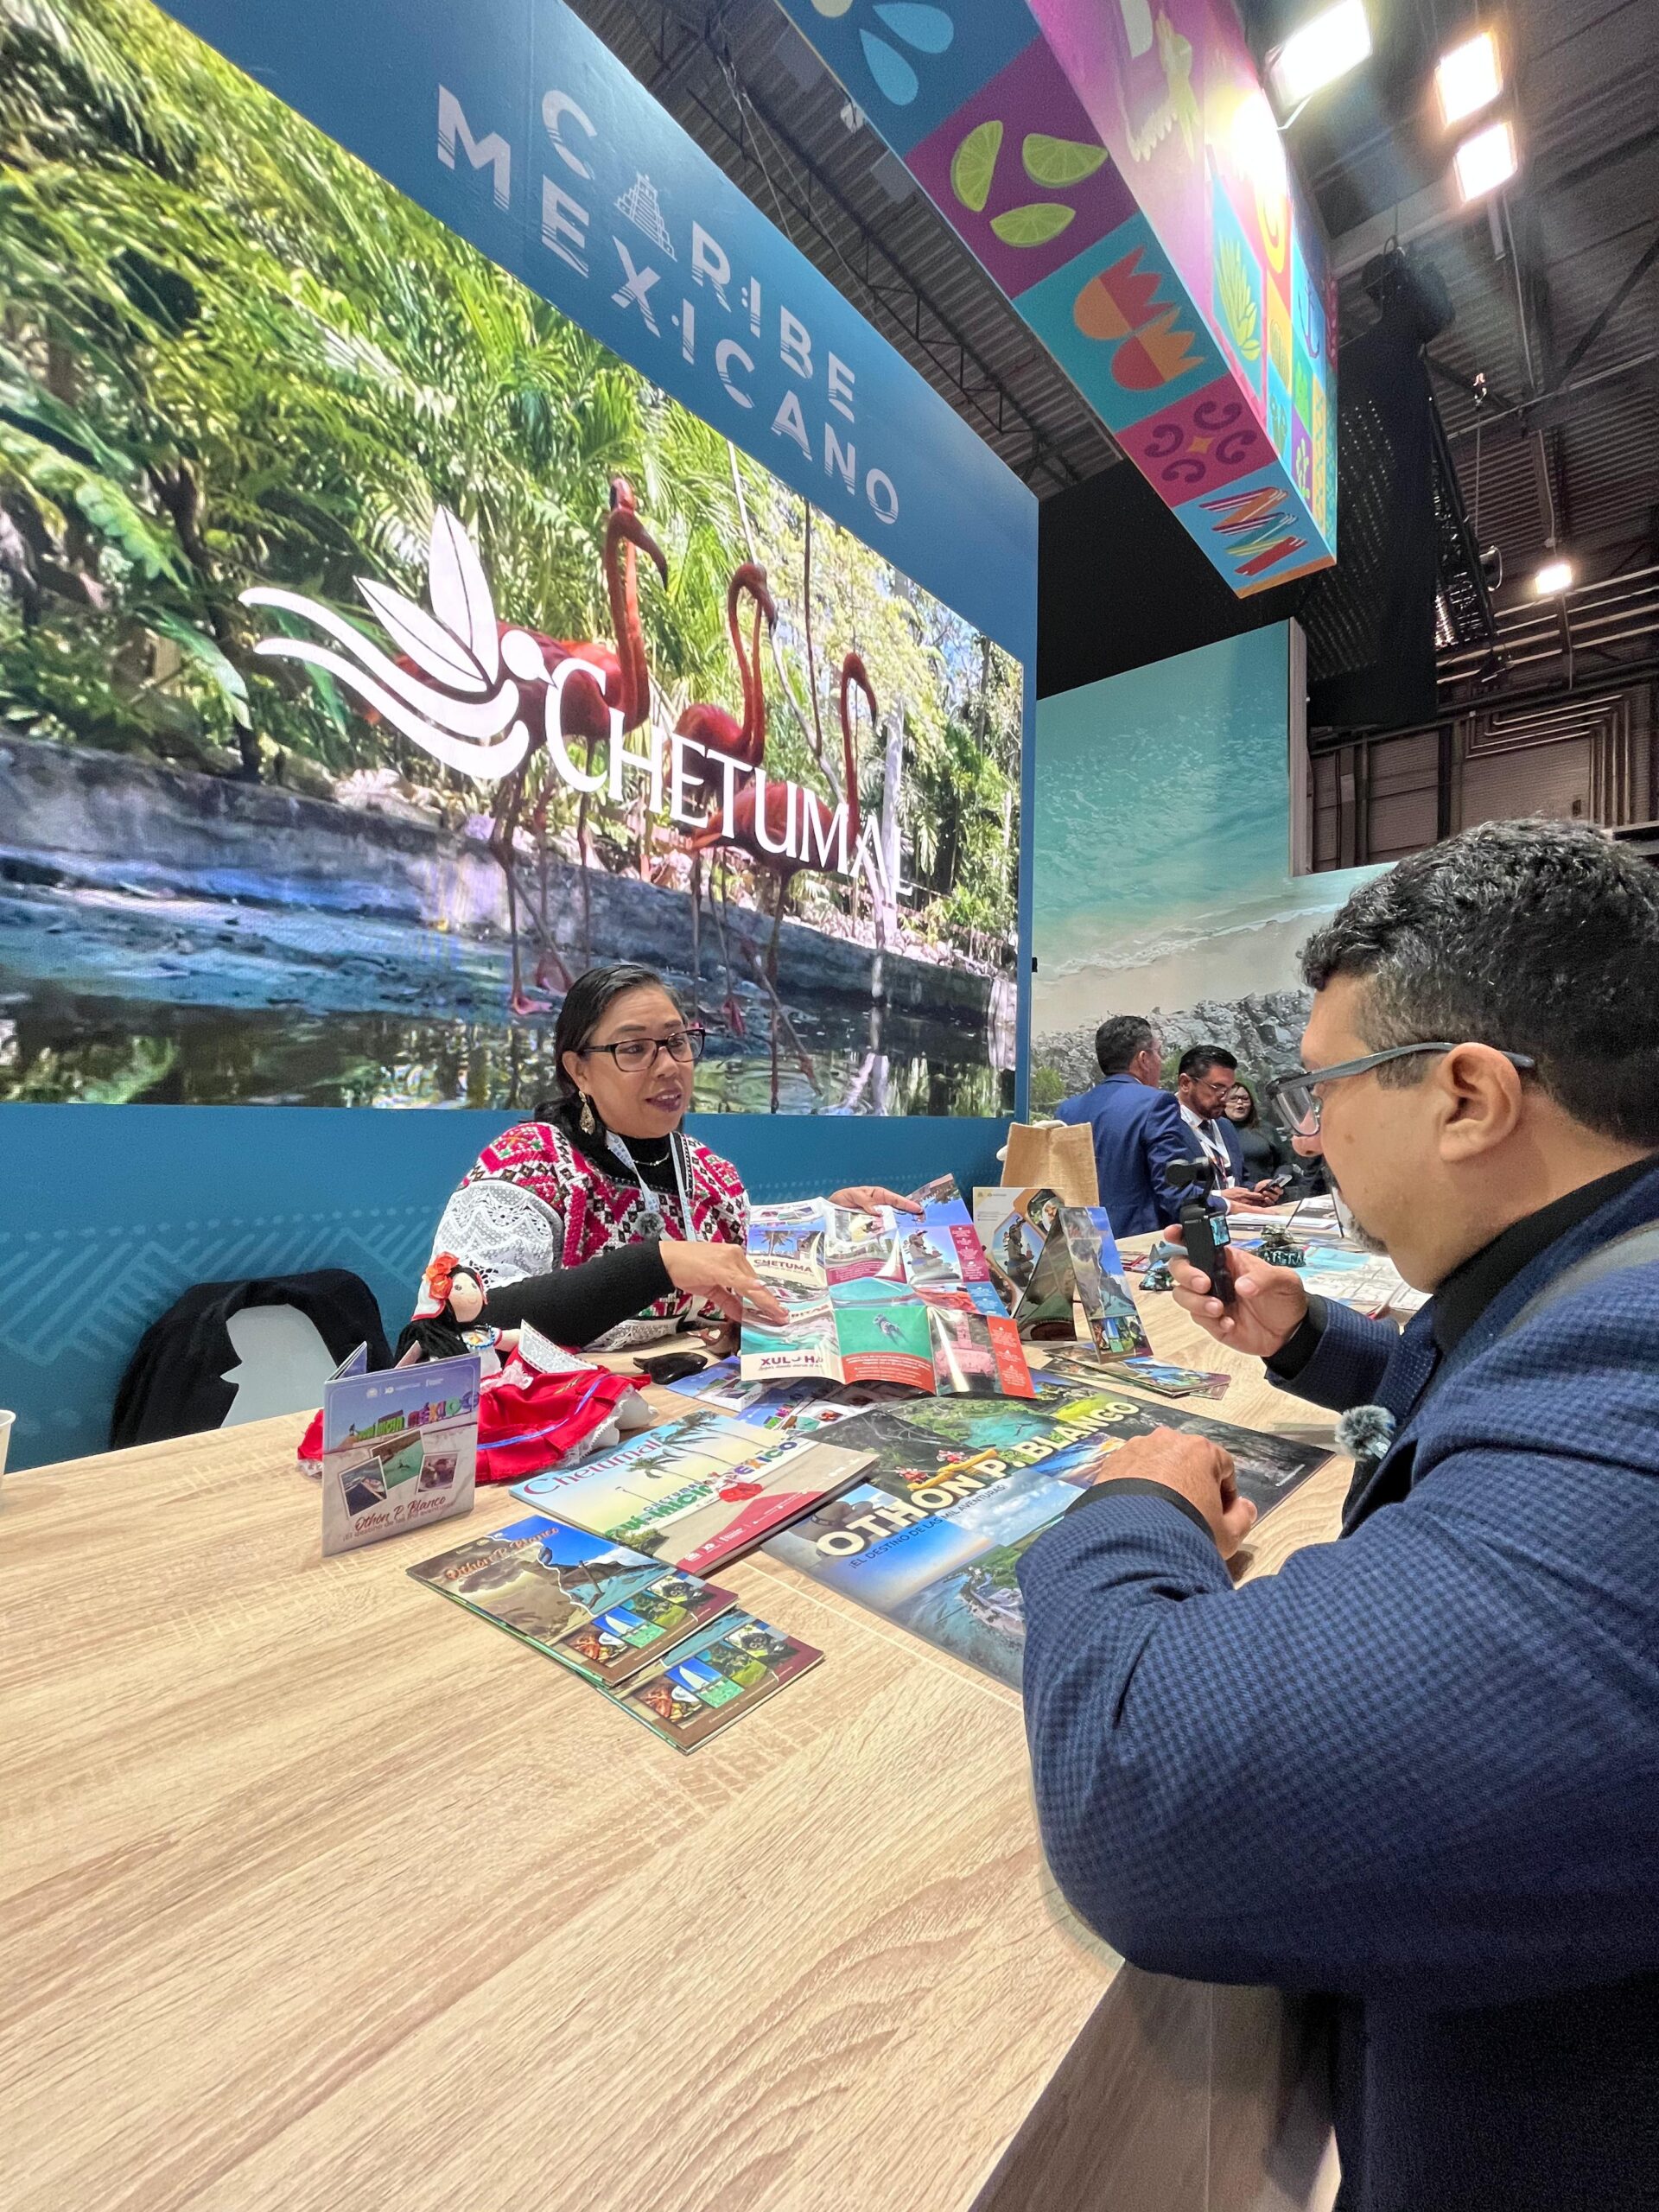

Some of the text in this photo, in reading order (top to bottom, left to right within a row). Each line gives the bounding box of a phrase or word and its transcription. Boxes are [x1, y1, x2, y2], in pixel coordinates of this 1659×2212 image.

[437, 83, 899, 525] MEXICANO
[753, 1258, 813, 1273] CHETUMA
[1012, 1402, 1140, 1460] BLANCO
[524, 1440, 663, 1495] Chetumal
[407, 1496, 447, 1513] Blanco
[866, 1533, 910, 1560] DESTINO
[908, 1525, 925, 1538] DE
[924, 1516, 944, 1529] LAS
[942, 1507, 961, 1521] MIL
